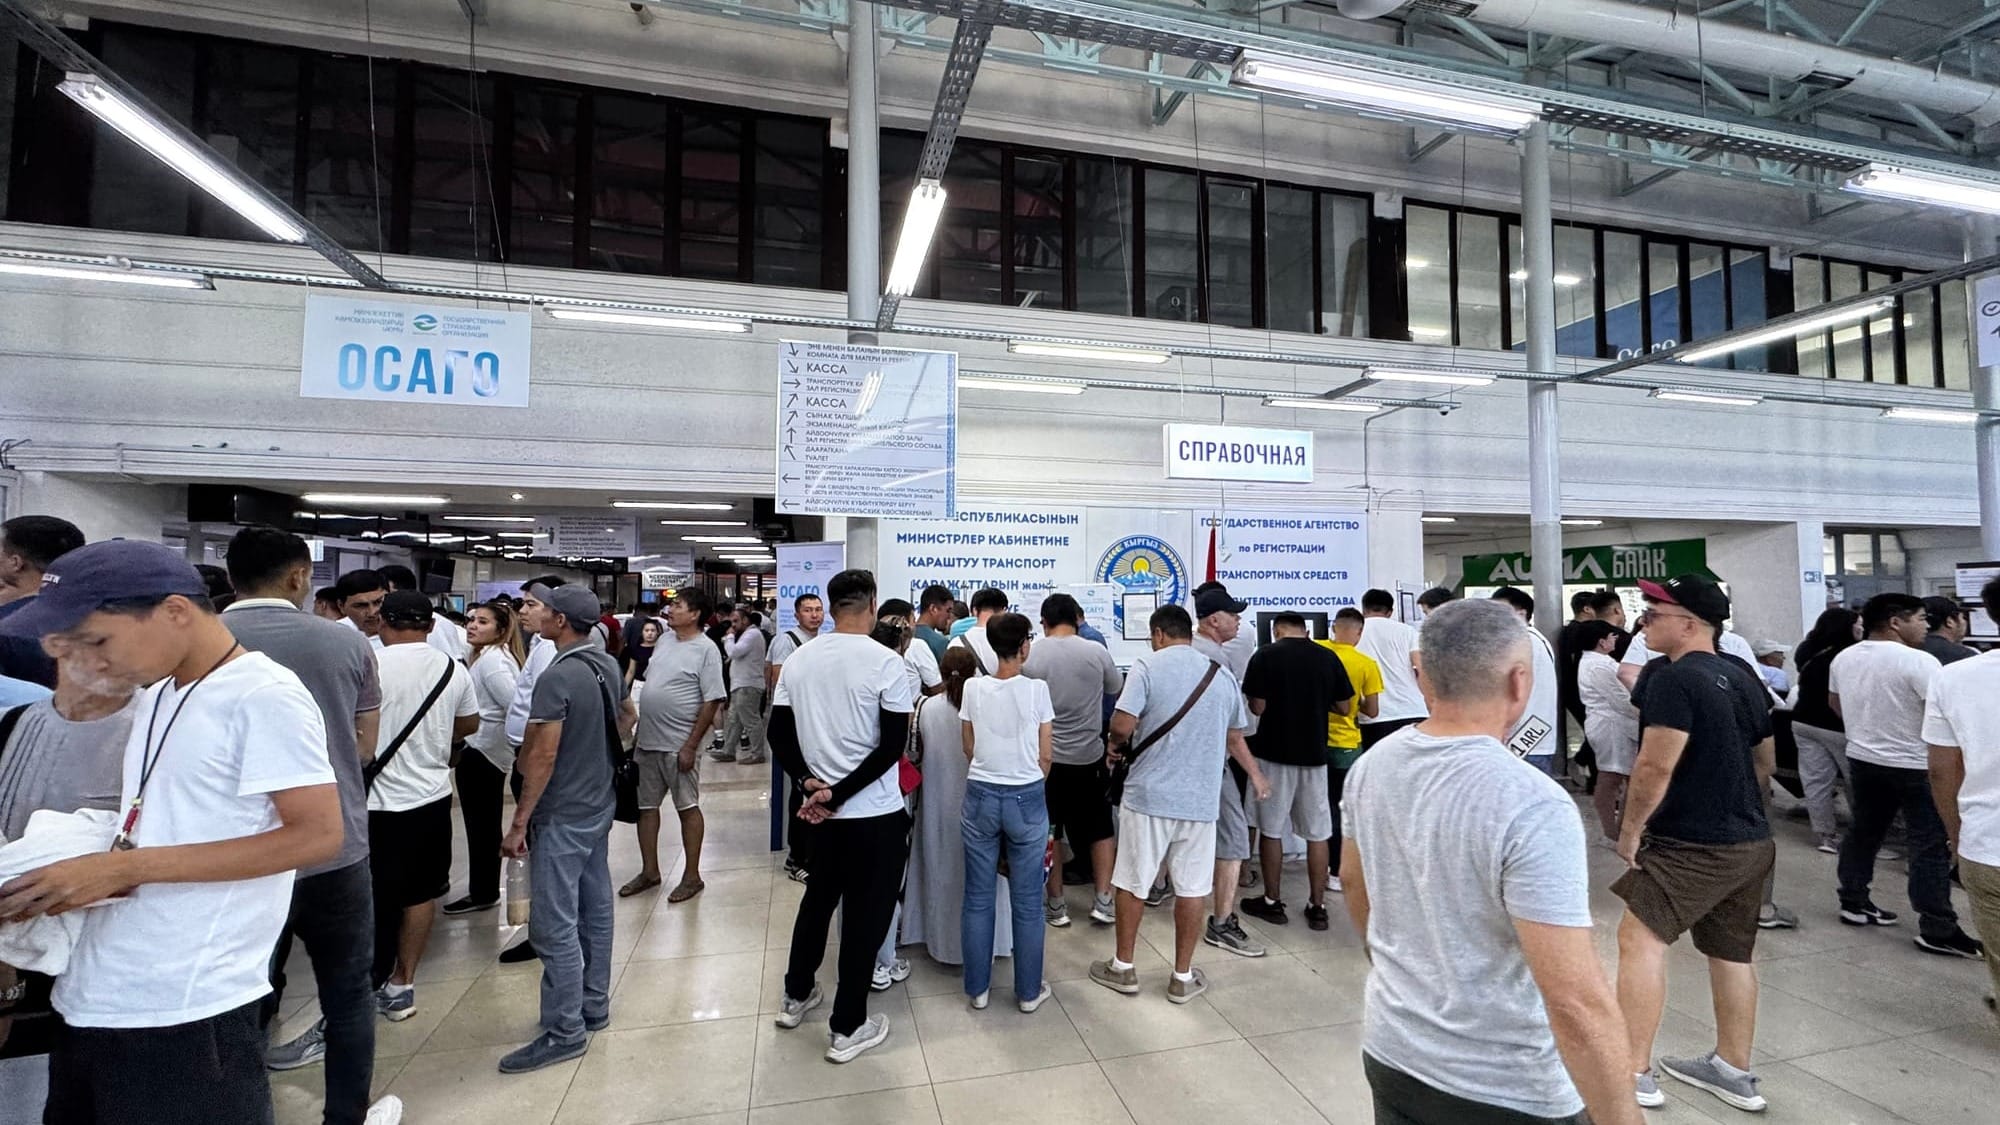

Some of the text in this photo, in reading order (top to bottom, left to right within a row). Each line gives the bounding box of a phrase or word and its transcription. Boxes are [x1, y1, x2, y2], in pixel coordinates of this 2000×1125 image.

[338, 343, 500, 397] ОСАГО
[807, 362, 848, 375] КАССА
[806, 396, 847, 409] КАССА
[1179, 439, 1306, 466] СПРАВОЧНАЯ
[1304, 519, 1360, 530] АГЕНТСТВО
[896, 532, 1069, 546] МИНИСТРЛЕР КАБИНЕТИНЕ
[1238, 543, 1326, 554] по РЕГИСТРАЦИИ
[907, 556, 1056, 569] КАРАШТУУ ТРАНСПОРТ
[1612, 548, 1667, 578] БАНК
[1216, 570, 1348, 580] ТРАНСПОРТНЫХ СРЕДСТВ
[1309, 597, 1355, 606] СОСТАВА
[1519, 727, 1545, 749] ARL
